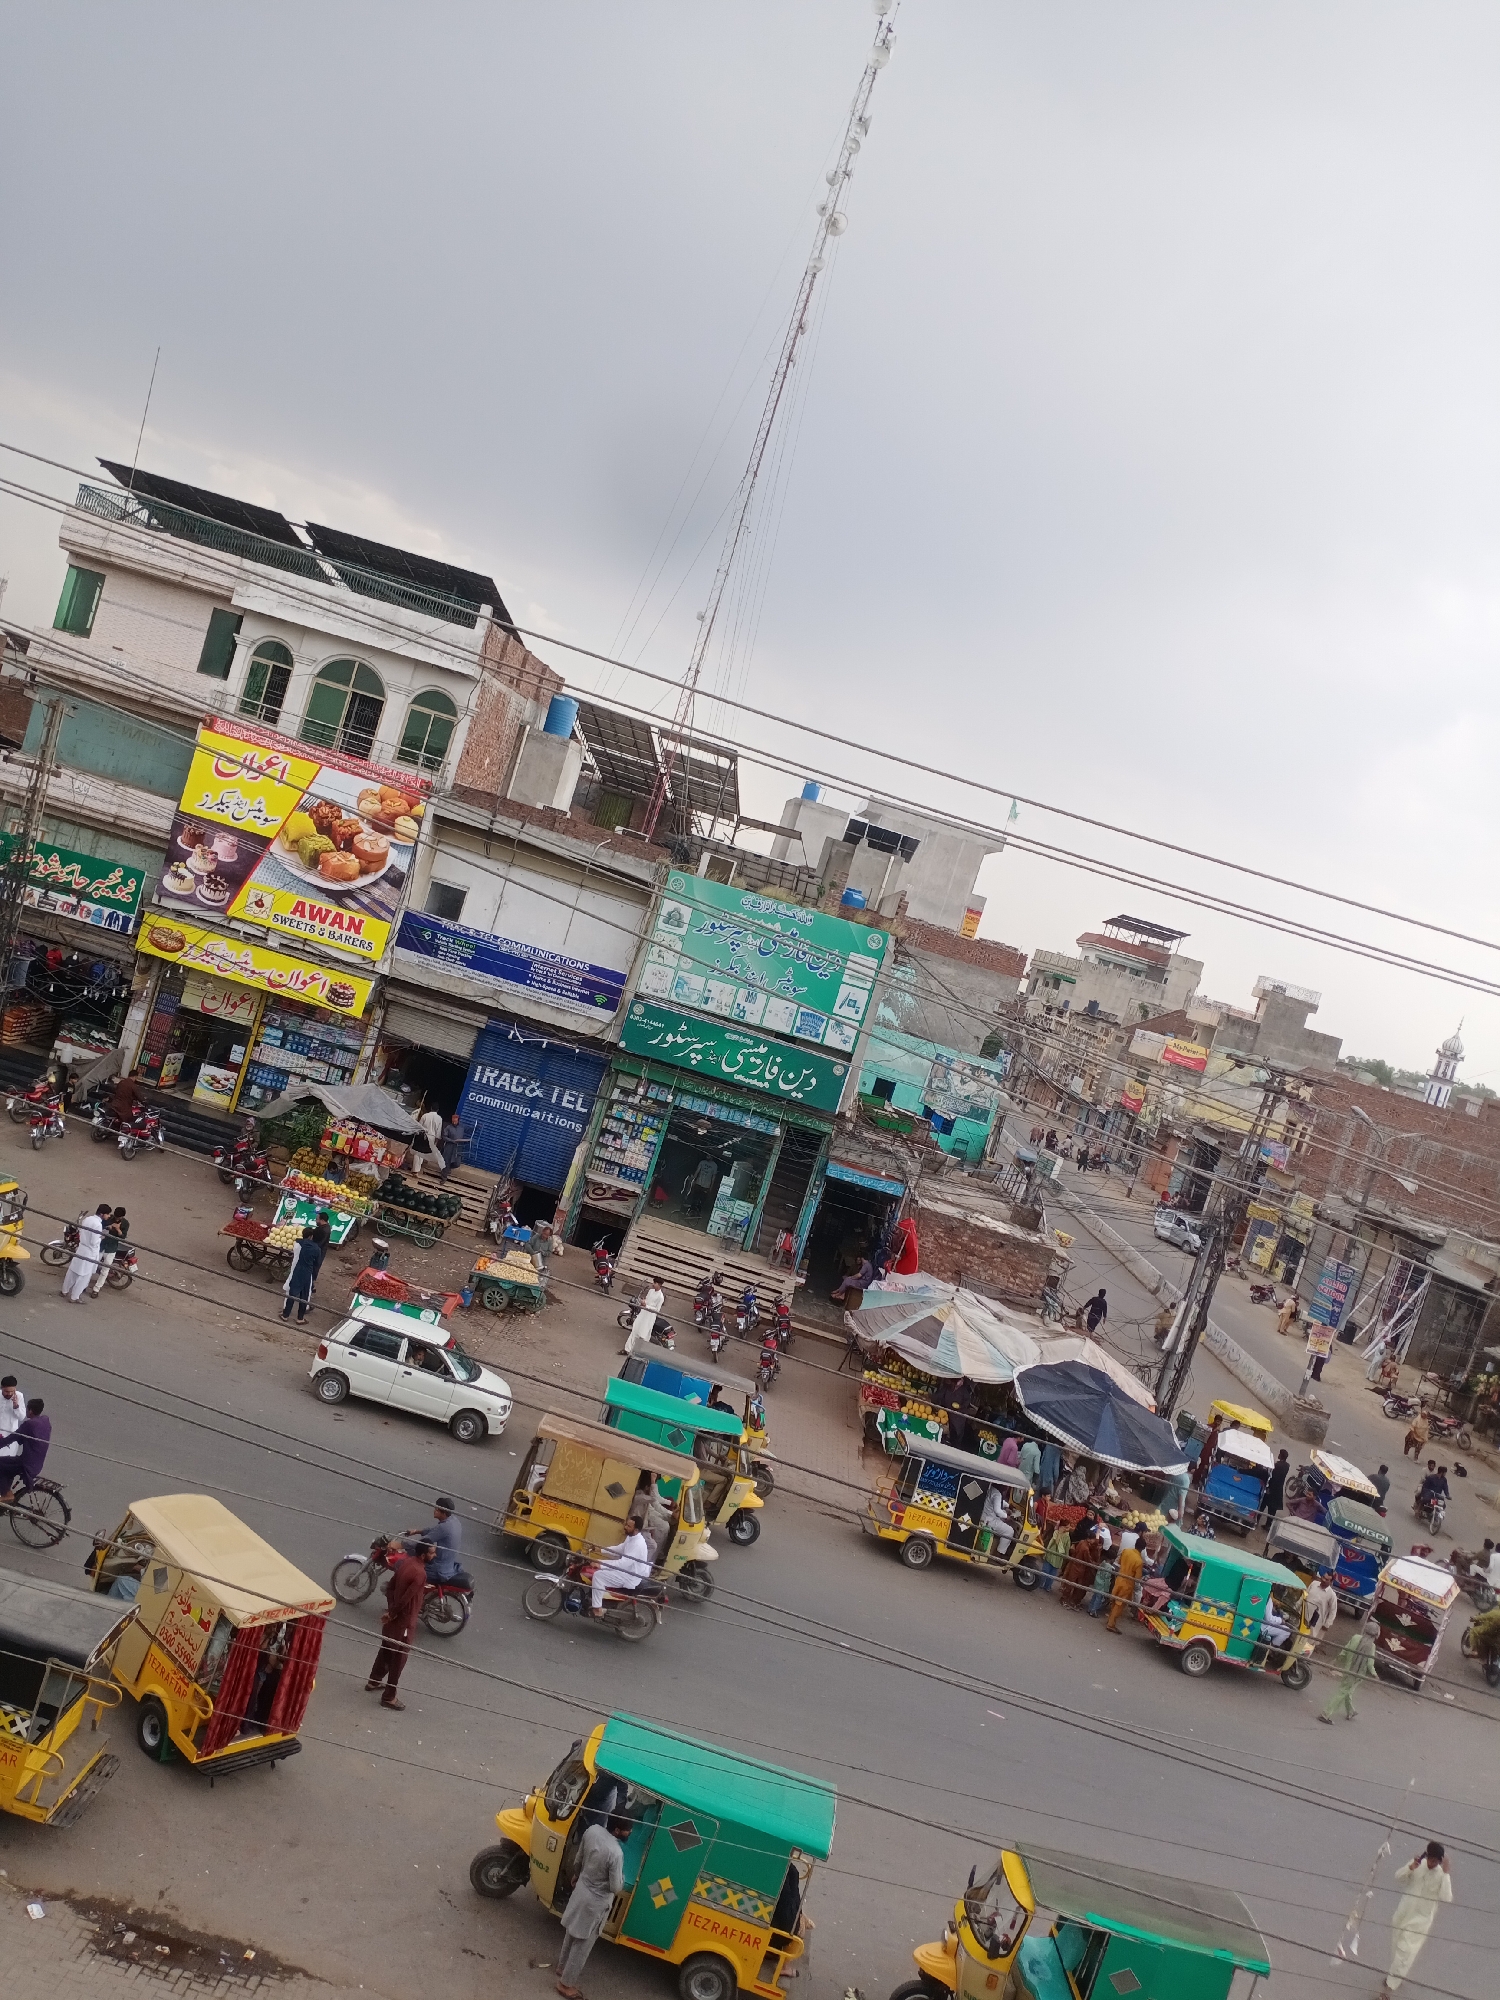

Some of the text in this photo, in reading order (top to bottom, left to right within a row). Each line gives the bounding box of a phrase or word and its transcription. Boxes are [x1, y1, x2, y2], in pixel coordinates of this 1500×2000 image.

[213, 751, 290, 786] اعوان
[272, 914, 374, 952] SWEETS & BAKERS
[290, 899, 365, 935] AWAN
[496, 937, 590, 971] COMMUNICATIONS
[531, 961, 583, 981] Internet Services
[265, 964, 329, 997] اعوان
[201, 988, 255, 1018] اعوان
[718, 1034, 785, 1086] فارمیسی
[523, 1076, 547, 1100] &
[549, 1083, 592, 1112] TEL
[775, 1059, 820, 1103] دین
[1315, 1284, 1347, 1302] SCHOOL
[536, 1505, 585, 1527] TEZRAFTAR
[907, 1511, 949, 1529] TEZRAFTAR
[1343, 1520, 1389, 1542] QINGQI
[158, 1625, 175, 1648] 0300
[148, 1652, 188, 1701] TEZRAFTAR
[687, 1911, 762, 1949] TEZRAFTAR
